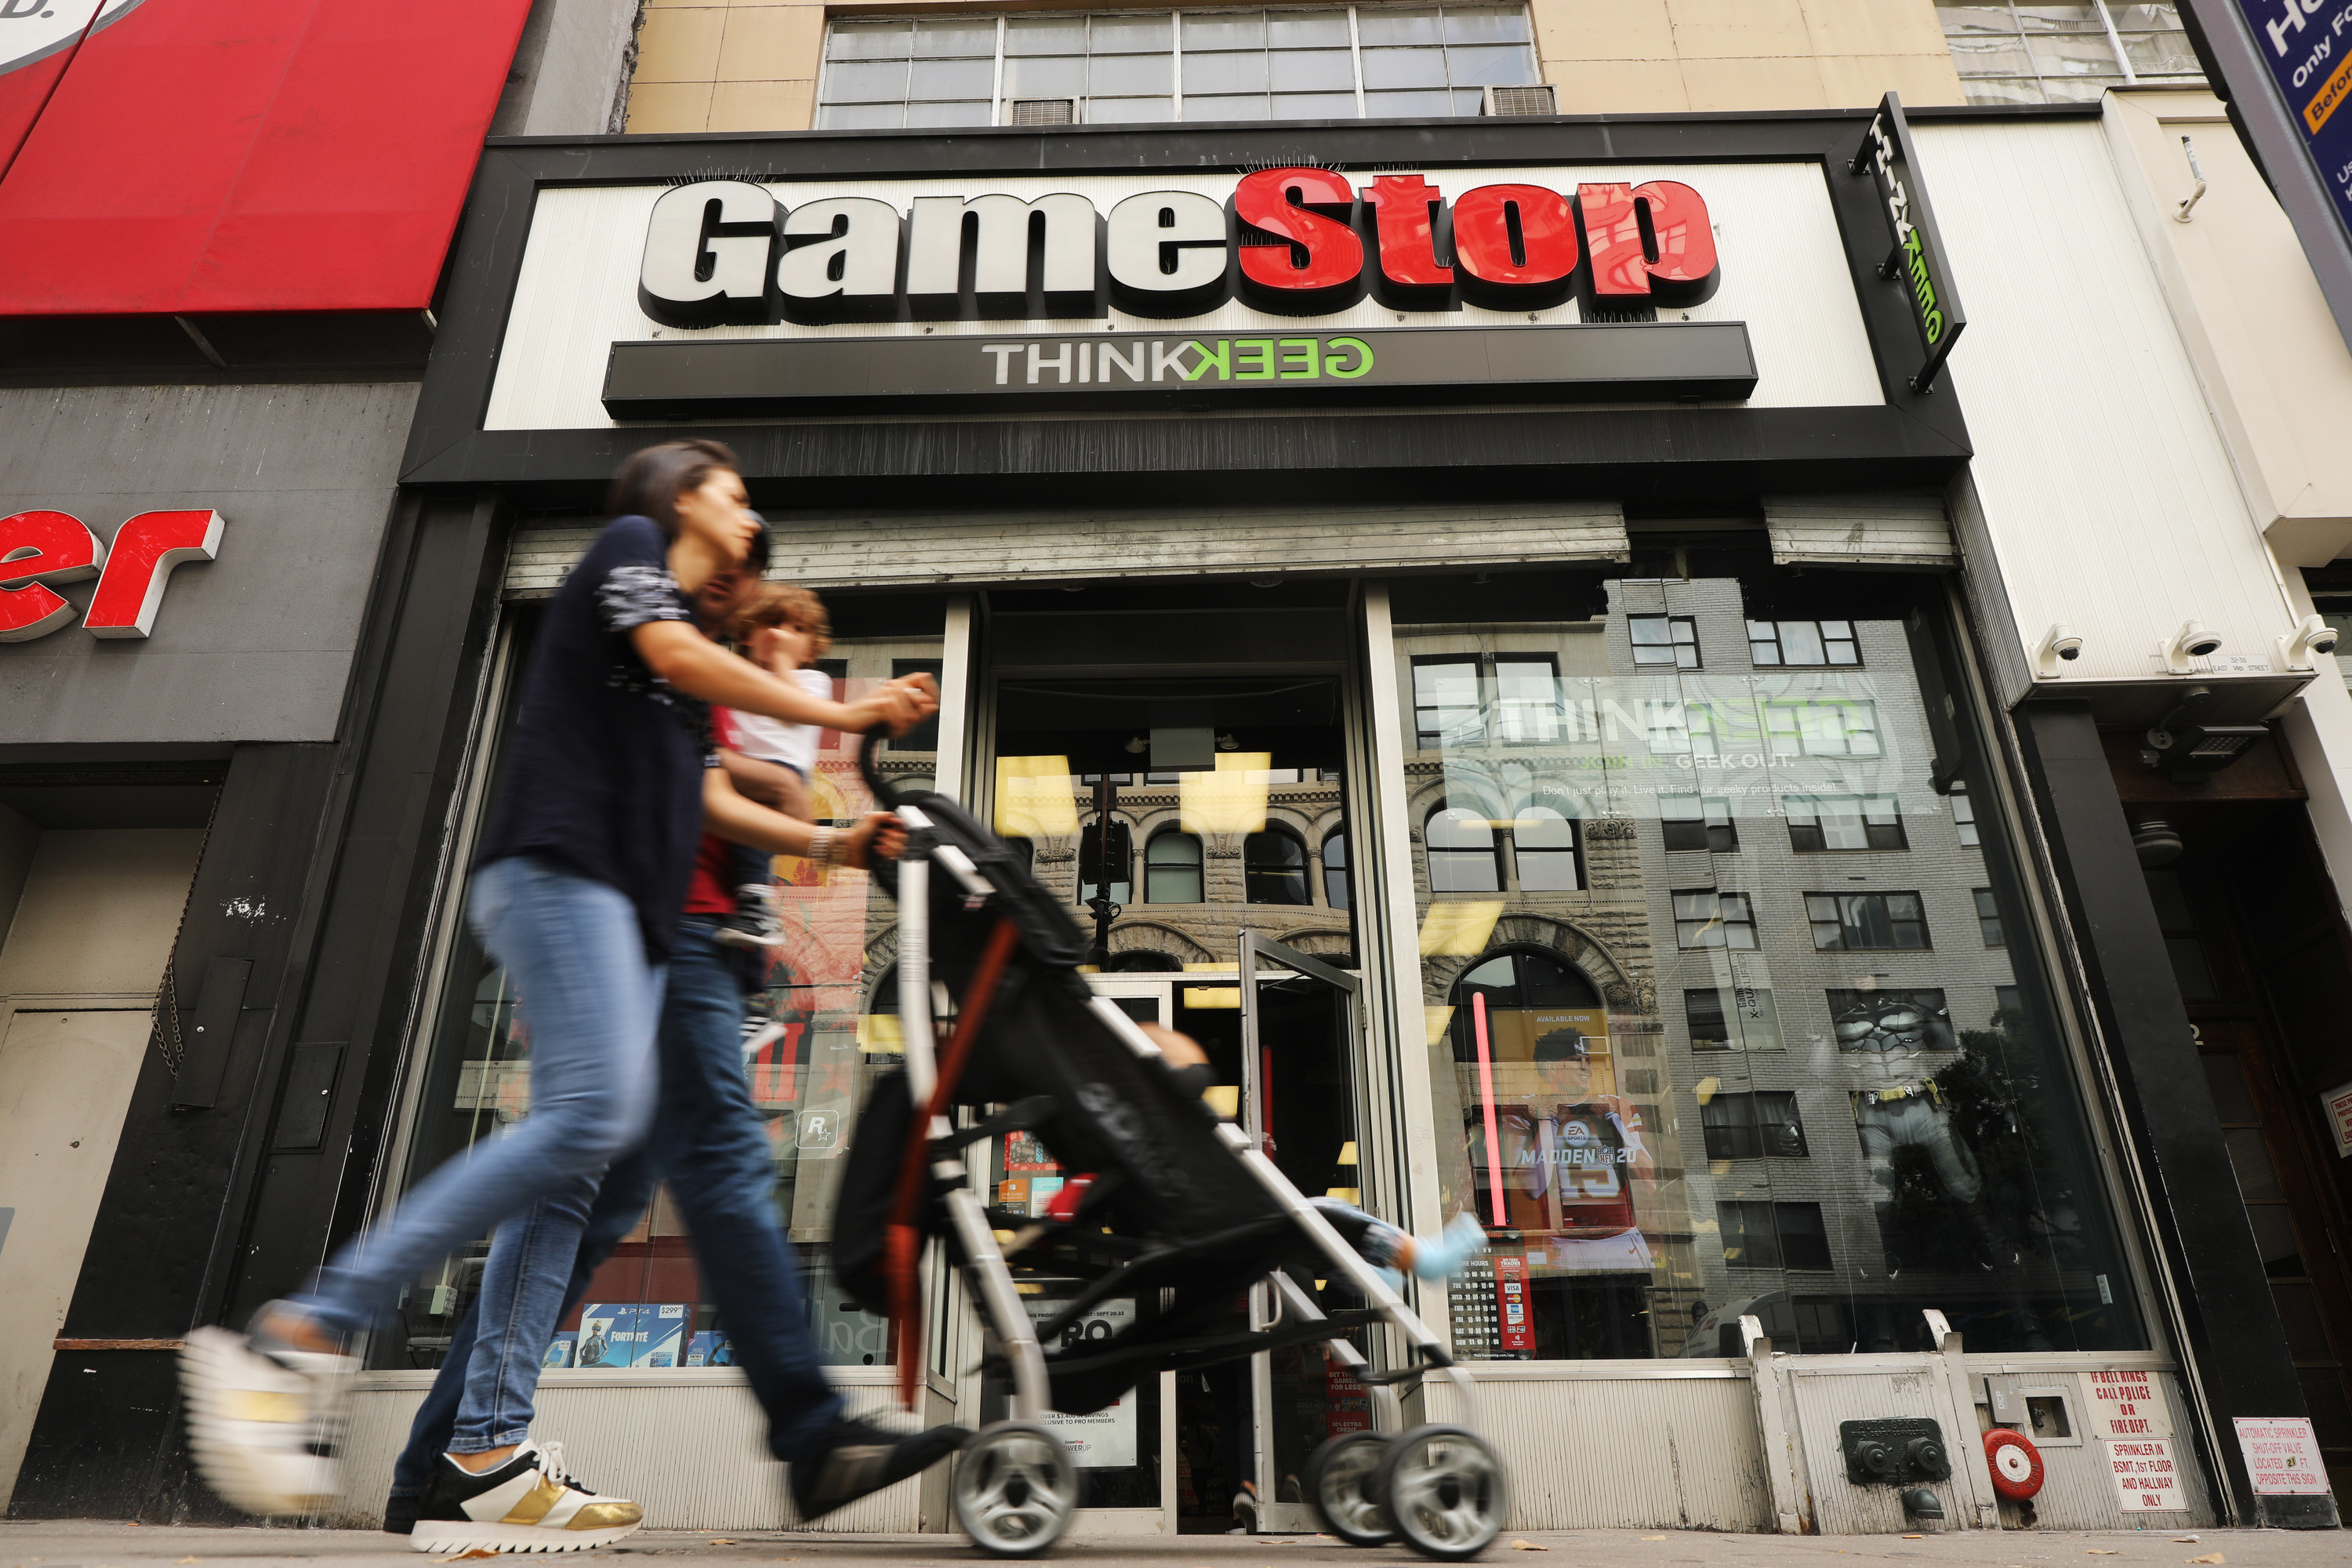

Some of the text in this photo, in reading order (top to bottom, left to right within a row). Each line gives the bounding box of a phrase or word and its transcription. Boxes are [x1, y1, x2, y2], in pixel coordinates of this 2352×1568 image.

[2292, 35, 2331, 88] Only
[640, 166, 1719, 325] GameStop
[982, 340, 1198, 385] THINK
[1492, 699, 1693, 742] THINK
[1579, 755, 1633, 770] JOIN
[1642, 754, 1669, 769] IN.
[1675, 753, 1737, 769] GEEK
[1543, 782, 1836, 799] Don't just play it. Live it. Find our geeky products inside!
[1568, 1126, 1585, 1135] EA
[1521, 1149, 1595, 1165] MADDEN
[1600, 1154, 1613, 1163] NFL
[1617, 1148, 1637, 1163] 20
[2091, 1371, 2148, 1383] IF BELL RINGS
[2096, 1386, 2151, 1399] CALL POLICE
[2120, 1403, 2136, 1415] OR
[1858, 1420, 1885, 1429] AUTO
[2110, 1419, 2152, 1433] FIRE DEPT.
[2239, 1427, 2308, 1439] AUTOMATIC SPRINKLER
[2012, 1446, 2029, 1461] ALARM
[2114, 1444, 2164, 1456] SPRINKLER IN
[2252, 1443, 2303, 1454] SHUT-OFF VALVE
[2148, 1460, 2173, 1472] FLOOR
[2253, 1458, 2283, 1469] LOCATED
[2299, 1458, 2310, 1468] FT.
[2025, 1464, 2040, 1489] ALARM
[2256, 1473, 2318, 1484] OPPOSITE THIS SIGN
[2122, 1477, 2173, 1490] AND HALLWAY
[2142, 1494, 2161, 1506] ONLY
